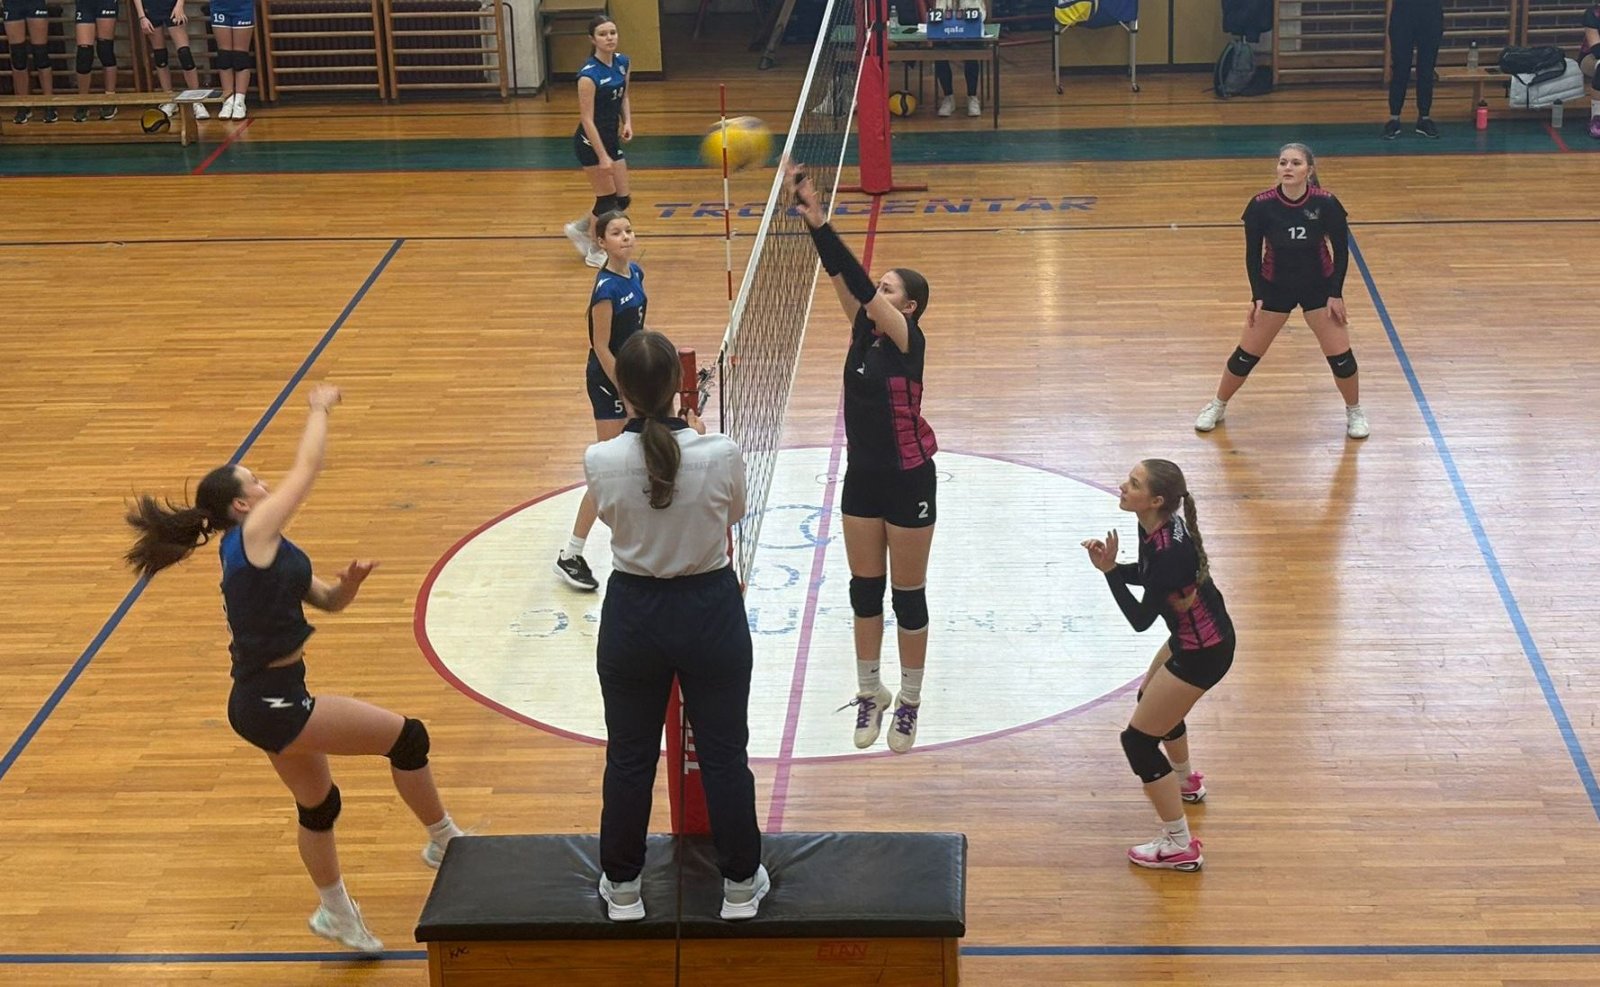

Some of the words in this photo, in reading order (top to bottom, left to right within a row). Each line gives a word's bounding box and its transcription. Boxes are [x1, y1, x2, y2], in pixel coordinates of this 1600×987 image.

[76, 12, 82, 20] 2
[213, 13, 225, 23] 19
[929, 11, 943, 21] 12
[965, 10, 979, 19] 19
[1288, 226, 1307, 240] 12
[614, 401, 624, 413] 5
[918, 501, 929, 519] 2
